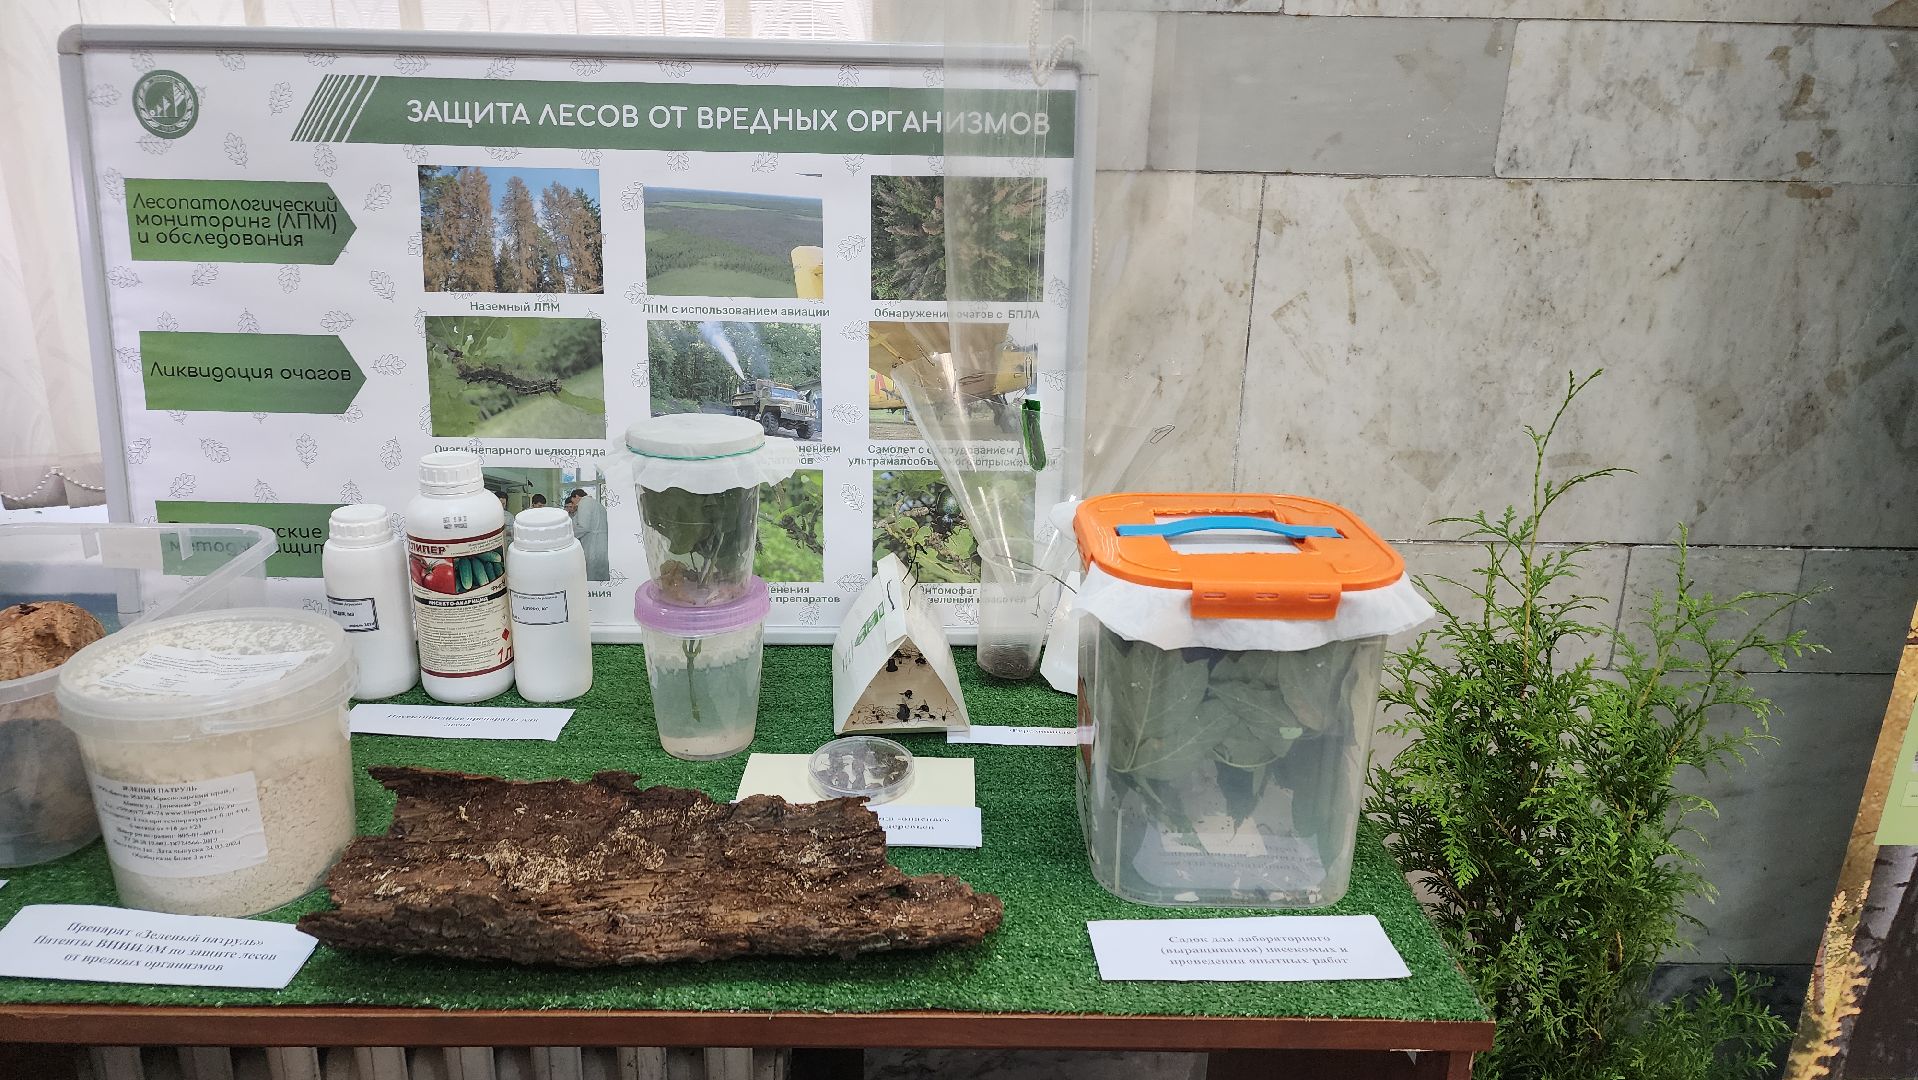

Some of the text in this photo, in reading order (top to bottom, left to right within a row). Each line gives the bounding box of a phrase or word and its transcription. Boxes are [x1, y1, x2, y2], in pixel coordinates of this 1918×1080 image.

[406, 99, 1051, 135] ЗАЩИТА ЛЕСОВ ОТ ВРЕДНЫХ ОРГАНИЗМОВ
[132, 193, 338, 213] Лесопатологический
[135, 213, 338, 235] мониторинг (ЛПМ)
[137, 227, 304, 249] и обследования
[469, 302, 560, 312] Наземный ЛПМ
[671, 306, 679, 314] с
[680, 306, 778, 316] использованием
[780, 308, 830, 317] авиации
[874, 307, 949, 320] Обнаружени
[1008, 309, 1041, 320] БПЛА
[150, 361, 352, 383] Ликвидация очагов
[471, 446, 532, 457] непарного
[534, 447, 606, 458] шелкопряда
[867, 444, 915, 455] Самолет
[409, 541, 447, 555] ЛИПЕР
[775, 596, 841, 605] препаратов
[66, 922, 132, 937] Препарат
